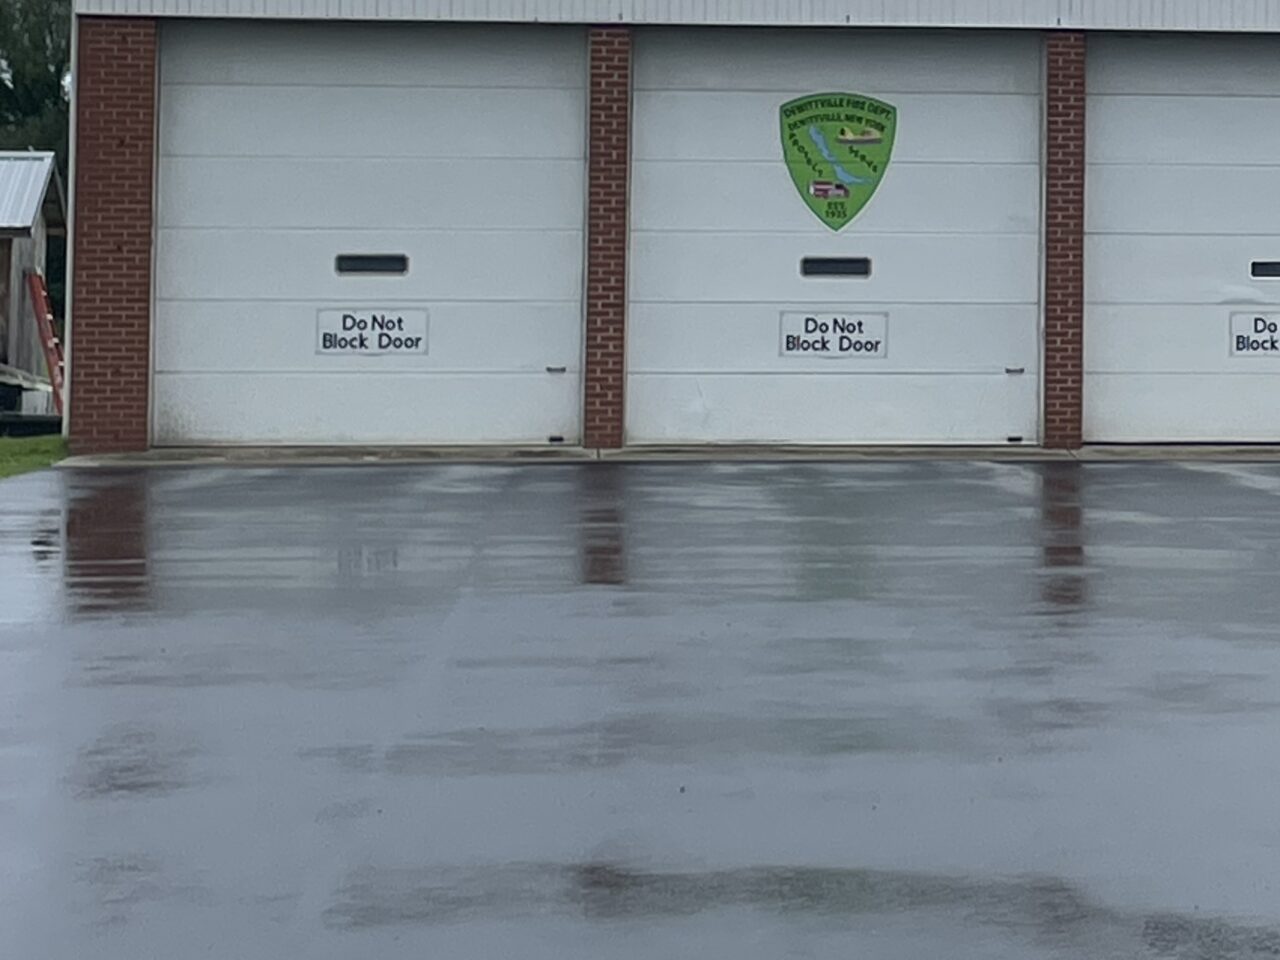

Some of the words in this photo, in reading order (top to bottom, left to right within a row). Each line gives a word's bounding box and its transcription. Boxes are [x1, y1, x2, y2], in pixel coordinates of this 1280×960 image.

[784, 98, 844, 118] DEWITTVILLE
[846, 98, 866, 110] FIRE
[342, 314, 368, 331] Do
[371, 314, 404, 331] Not
[805, 317, 829, 334] Do
[833, 317, 864, 334] Not
[1254, 317, 1278, 334] Do
[322, 332, 369, 349] Block
[378, 332, 422, 349] Door
[786, 334, 831, 351] Block
[839, 335, 881, 352] Door
[1236, 335, 1279, 351] Block
